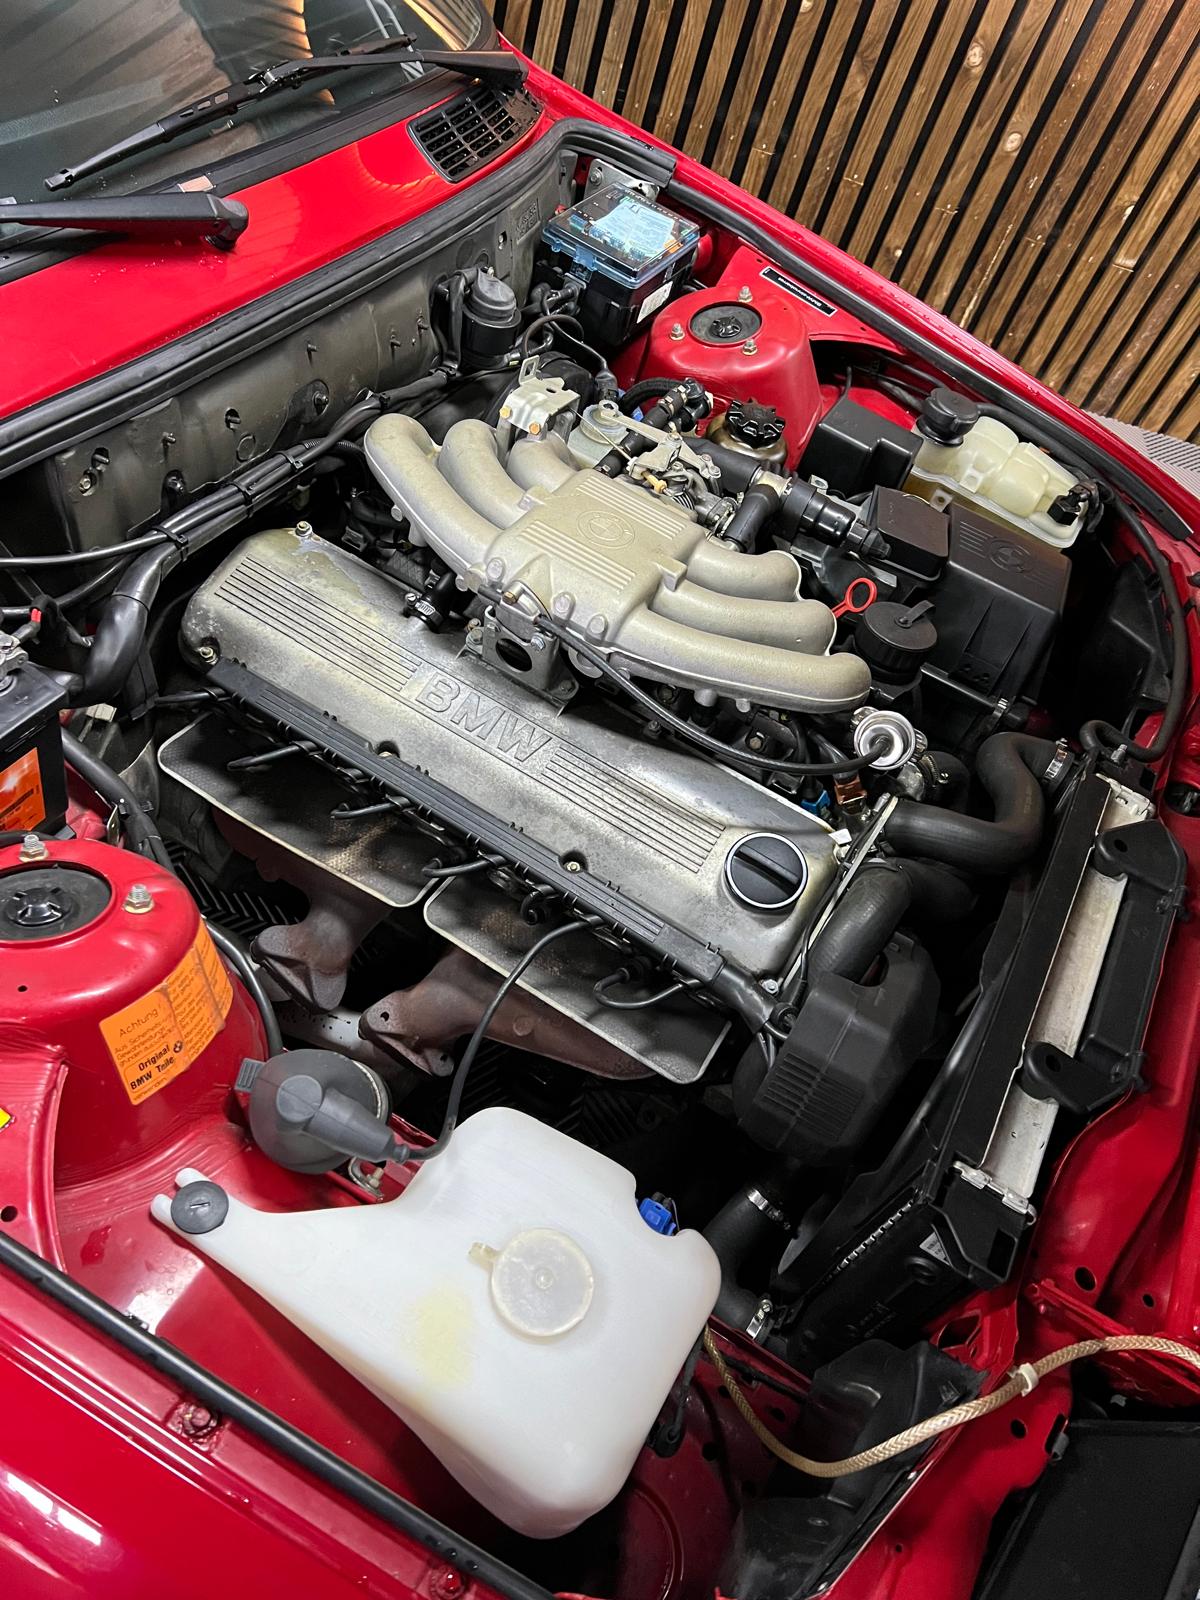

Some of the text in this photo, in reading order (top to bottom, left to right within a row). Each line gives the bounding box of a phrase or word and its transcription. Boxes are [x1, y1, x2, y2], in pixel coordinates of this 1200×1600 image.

[415, 672, 552, 762] BMW
[138, 1044, 170, 1071] Original
[130, 1071, 152, 1090] BMW
